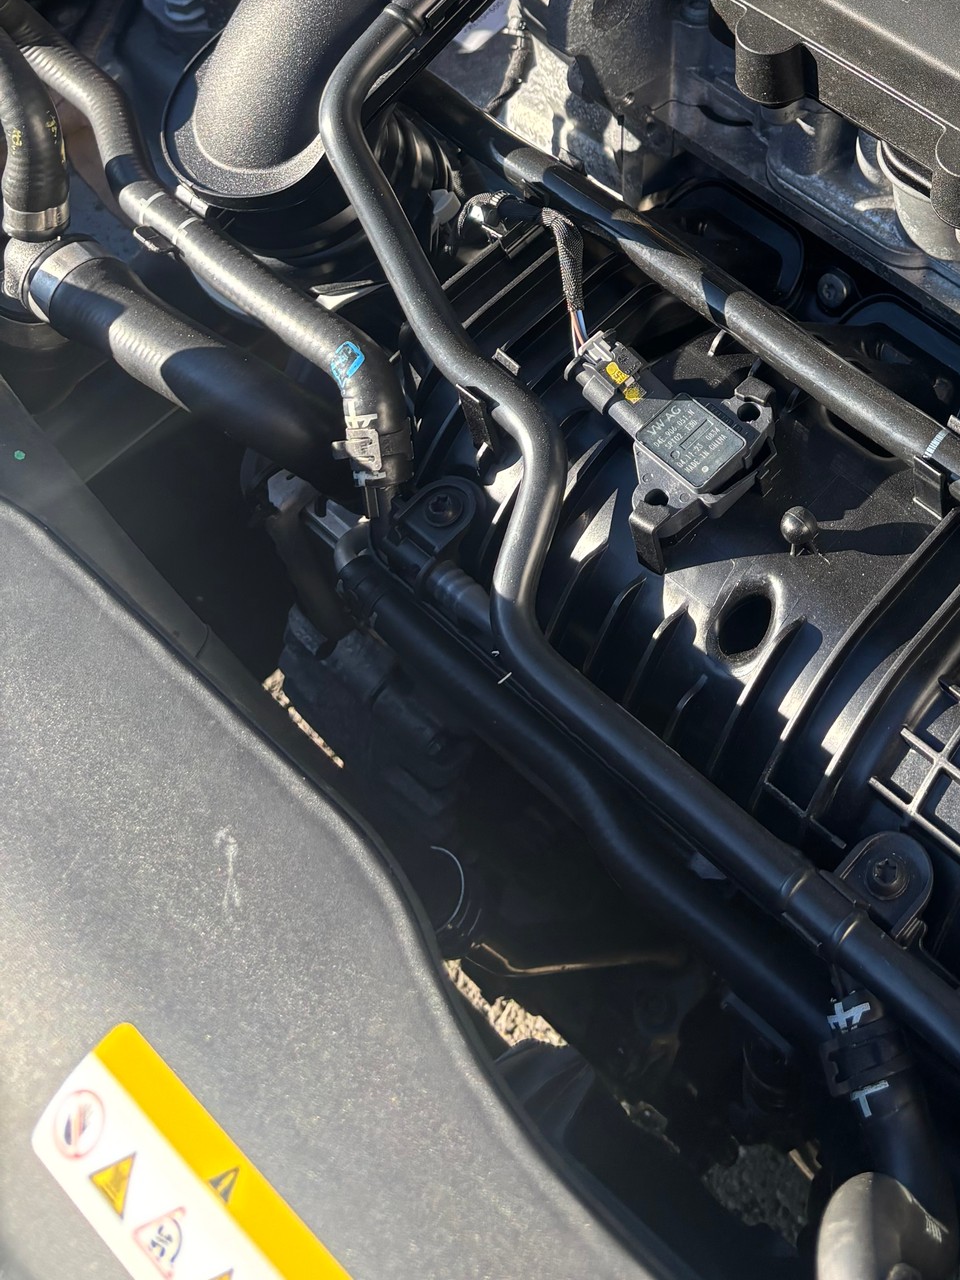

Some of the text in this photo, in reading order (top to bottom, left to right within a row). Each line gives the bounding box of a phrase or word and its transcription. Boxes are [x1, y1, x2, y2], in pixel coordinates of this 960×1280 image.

[646, 405, 682, 436] VW AG
[684, 459, 701, 474] MADE
[708, 433, 728, 451] CHINA
